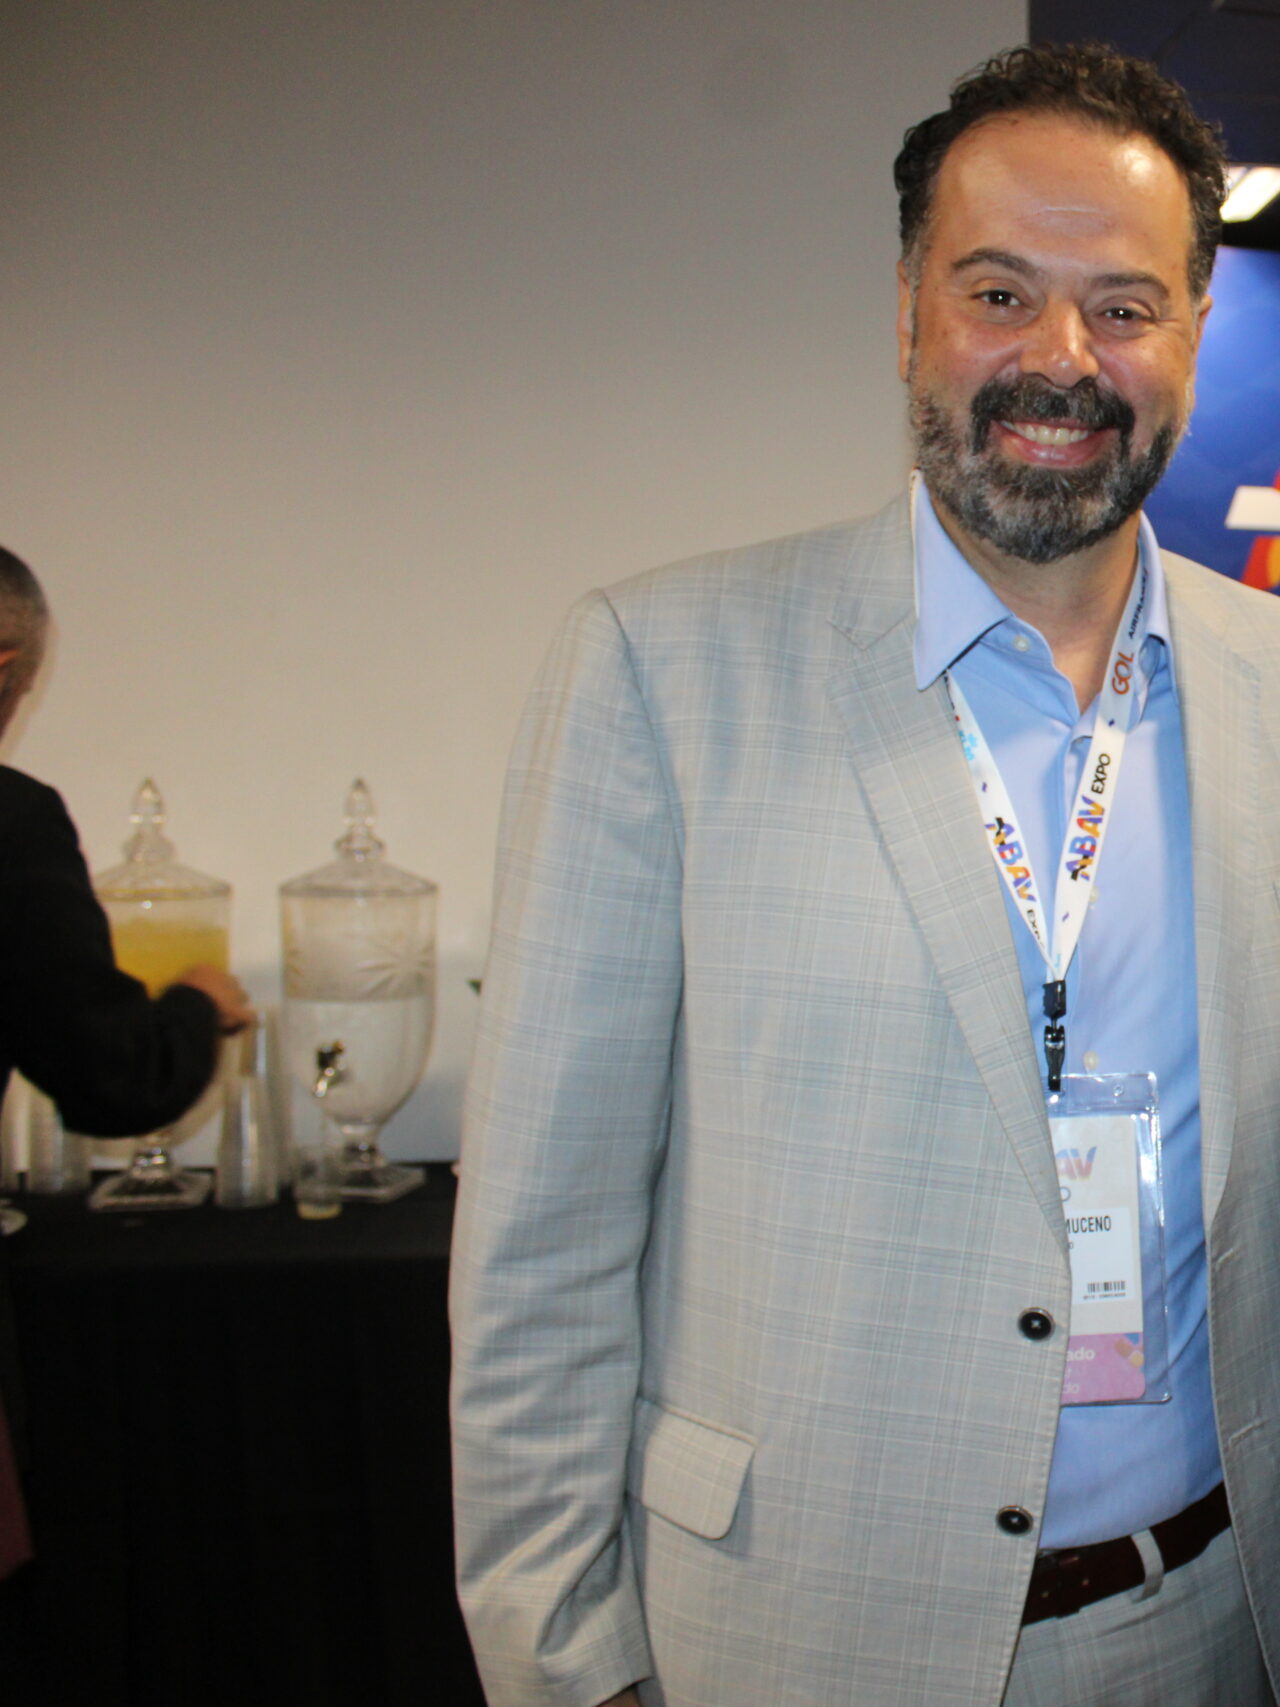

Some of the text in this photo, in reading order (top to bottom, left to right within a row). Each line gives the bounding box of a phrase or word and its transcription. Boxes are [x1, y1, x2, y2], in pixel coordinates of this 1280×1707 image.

[1112, 652, 1134, 695] GOL
[985, 817, 1037, 902] ABAV
[1066, 753, 1111, 882] ABAV EXPO
